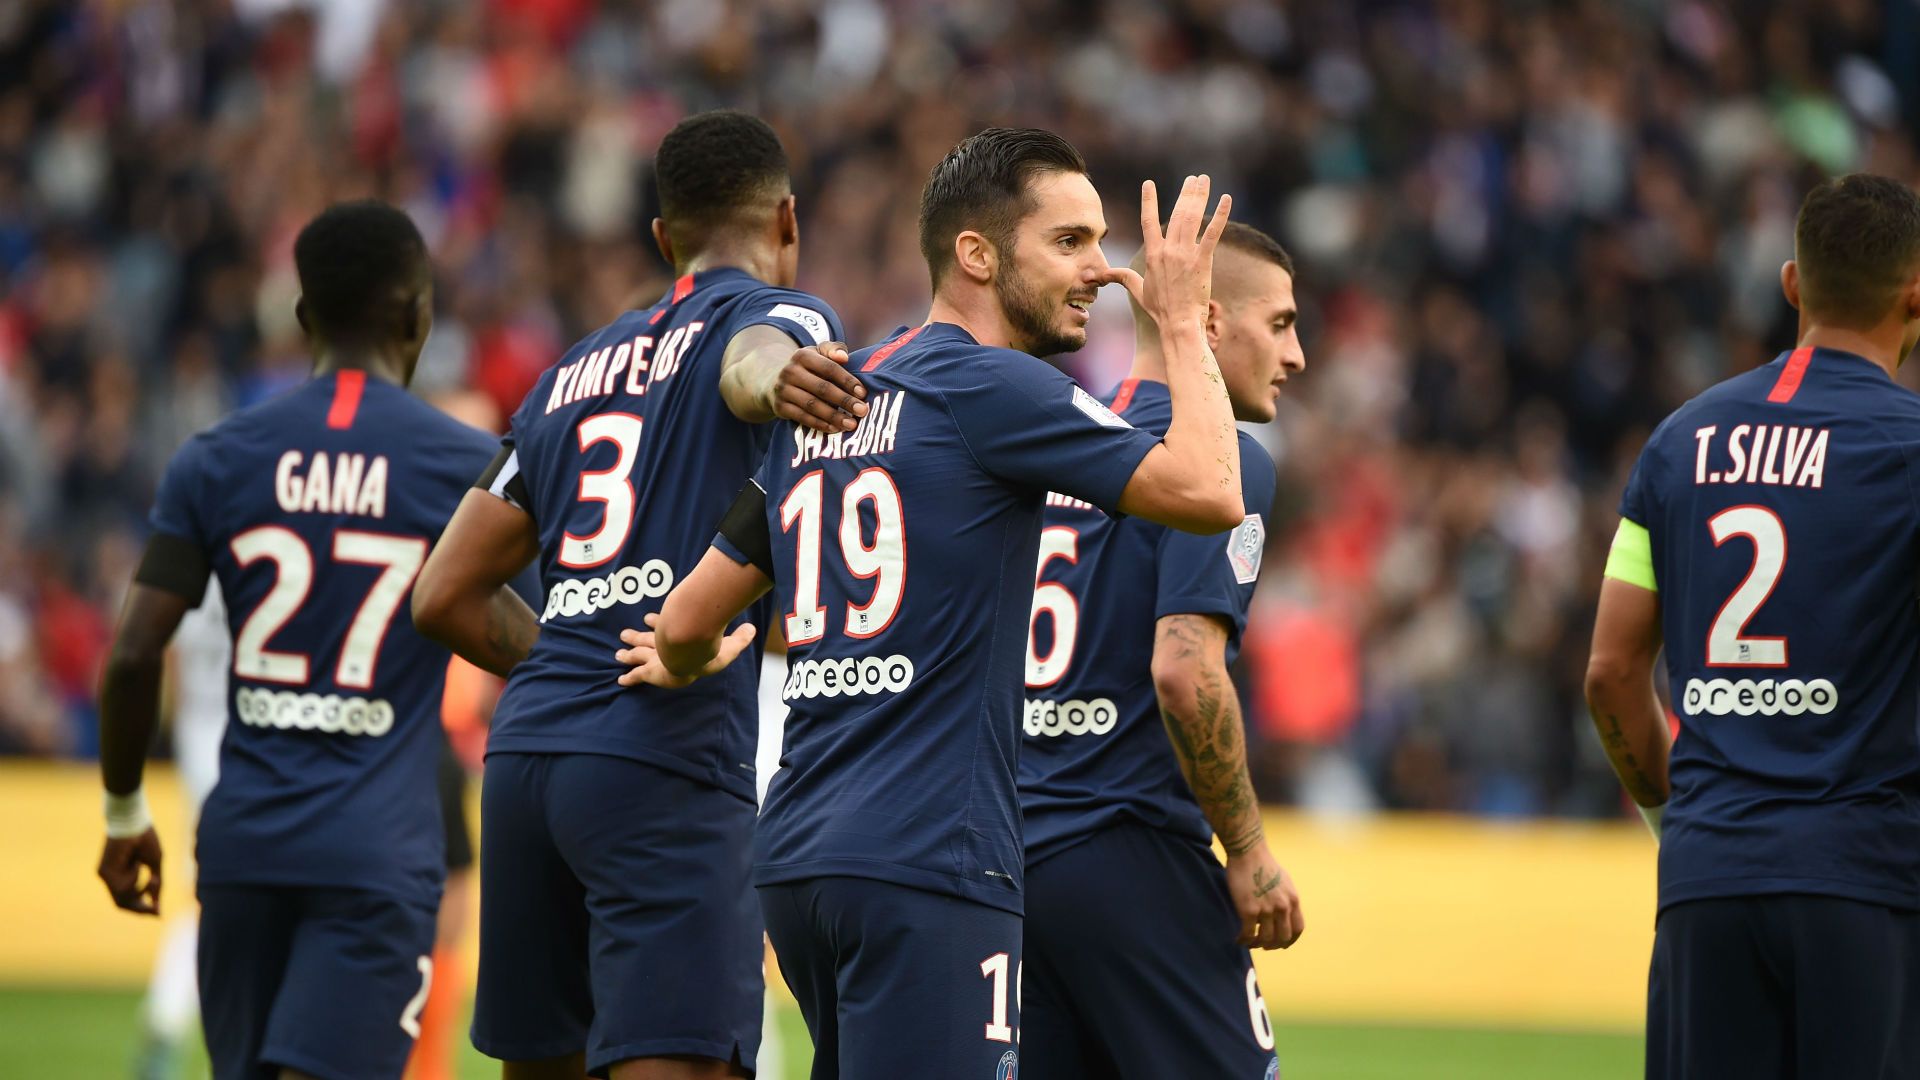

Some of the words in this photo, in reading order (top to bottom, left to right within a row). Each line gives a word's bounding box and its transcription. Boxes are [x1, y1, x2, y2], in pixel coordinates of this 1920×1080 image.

[275, 450, 388, 518] GANA
[557, 411, 643, 569] 3
[1695, 424, 1830, 488] T.SILVA
[229, 523, 429, 689] 27
[779, 465, 907, 647] 19
[1024, 525, 1080, 689] 6
[1705, 503, 1789, 668] 2
[1245, 966, 1275, 1051] 6
